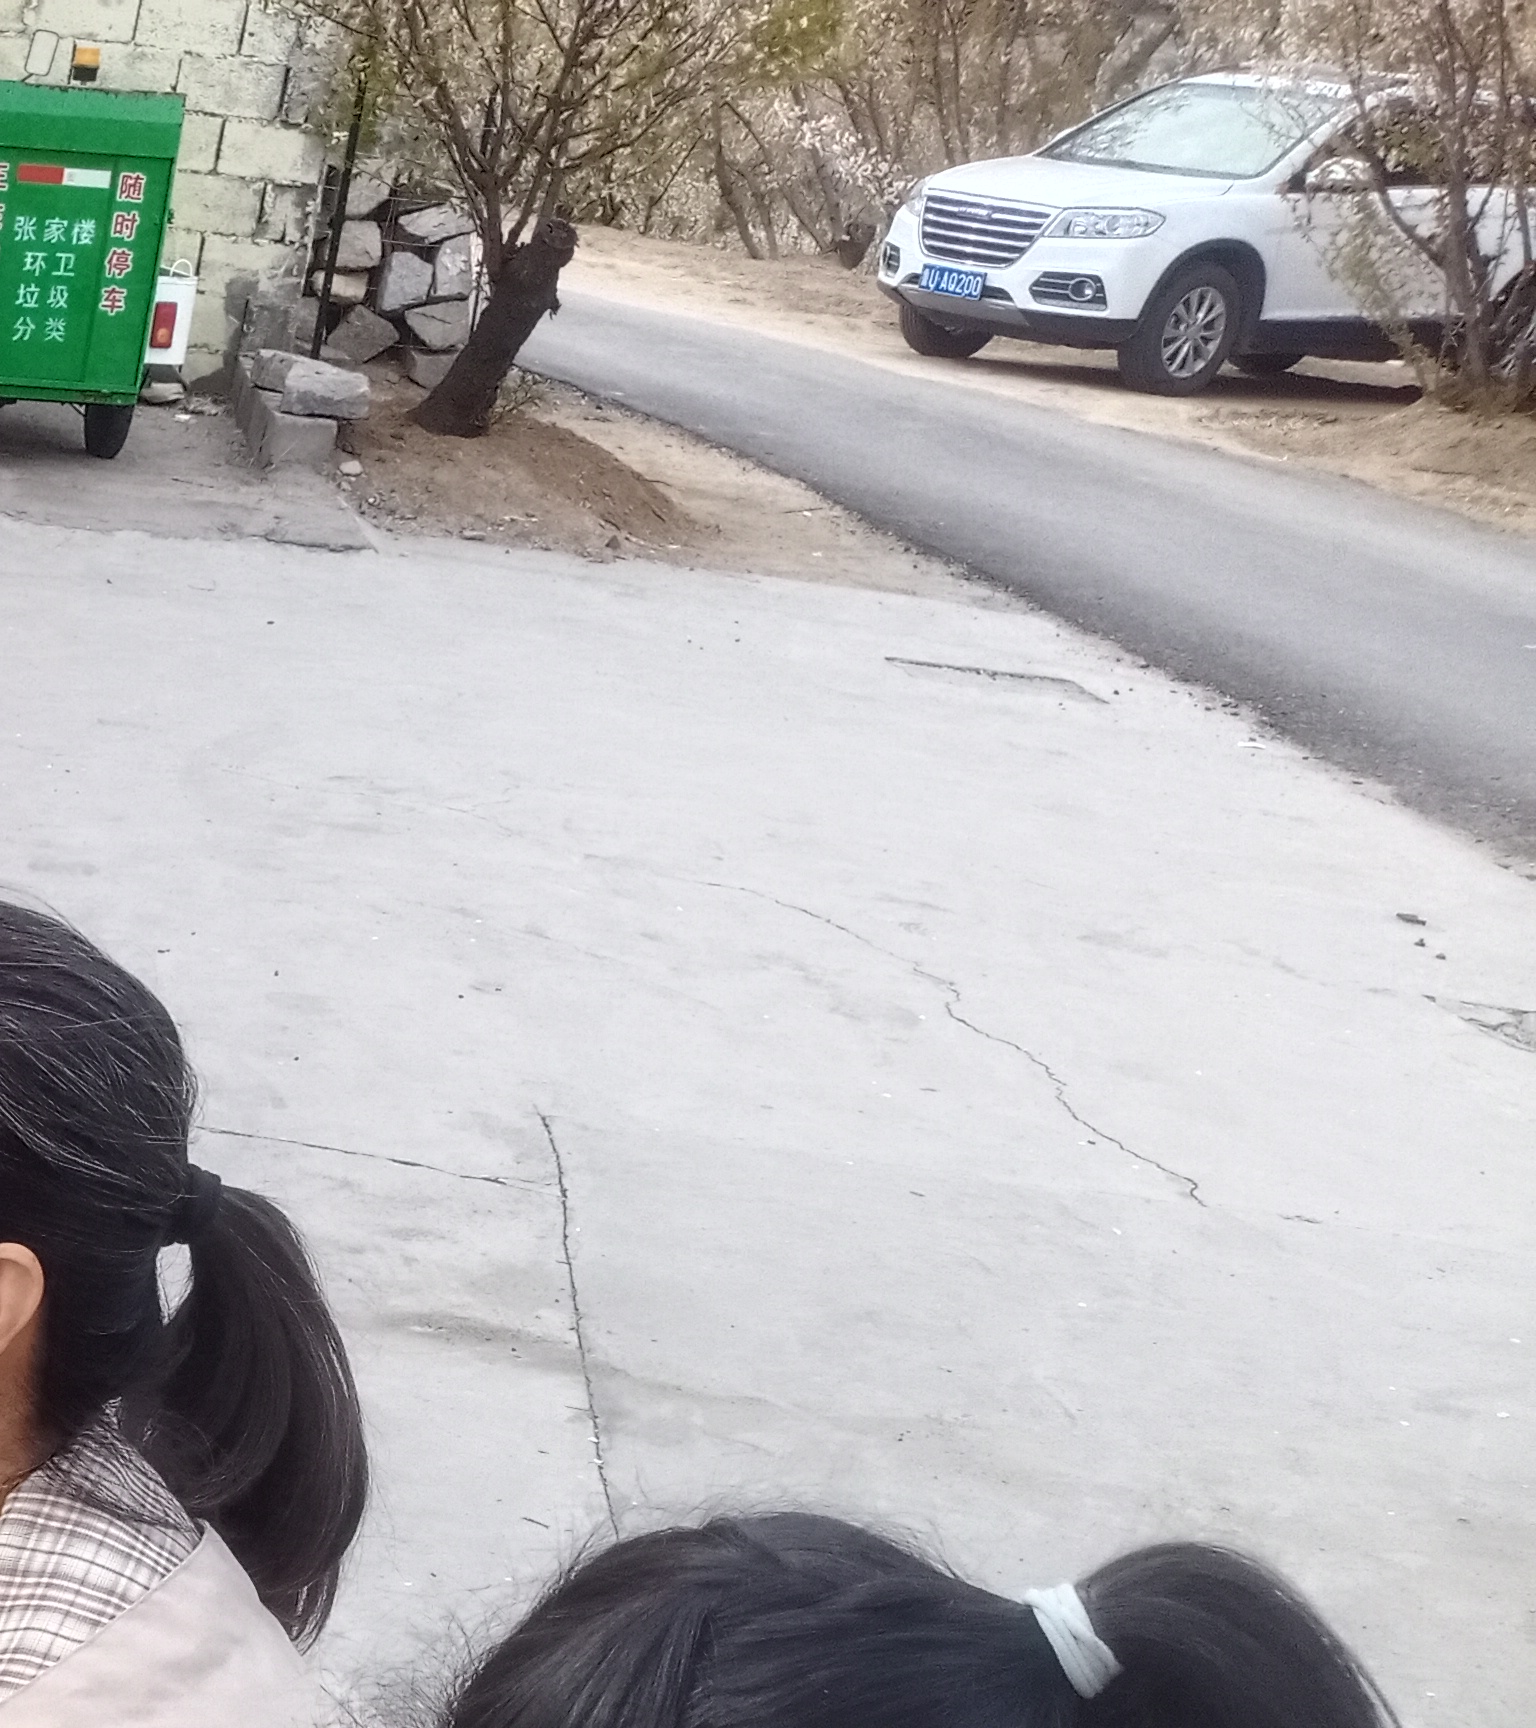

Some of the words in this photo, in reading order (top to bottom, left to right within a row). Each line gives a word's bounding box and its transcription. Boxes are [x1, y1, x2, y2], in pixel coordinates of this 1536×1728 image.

[14, 216, 96, 245] 张家楼
[99, 172, 146, 317] 随时停车
[22, 251, 76, 277] 环卫
[14, 284, 68, 309] 垃圾
[12, 317, 67, 342] 分类
